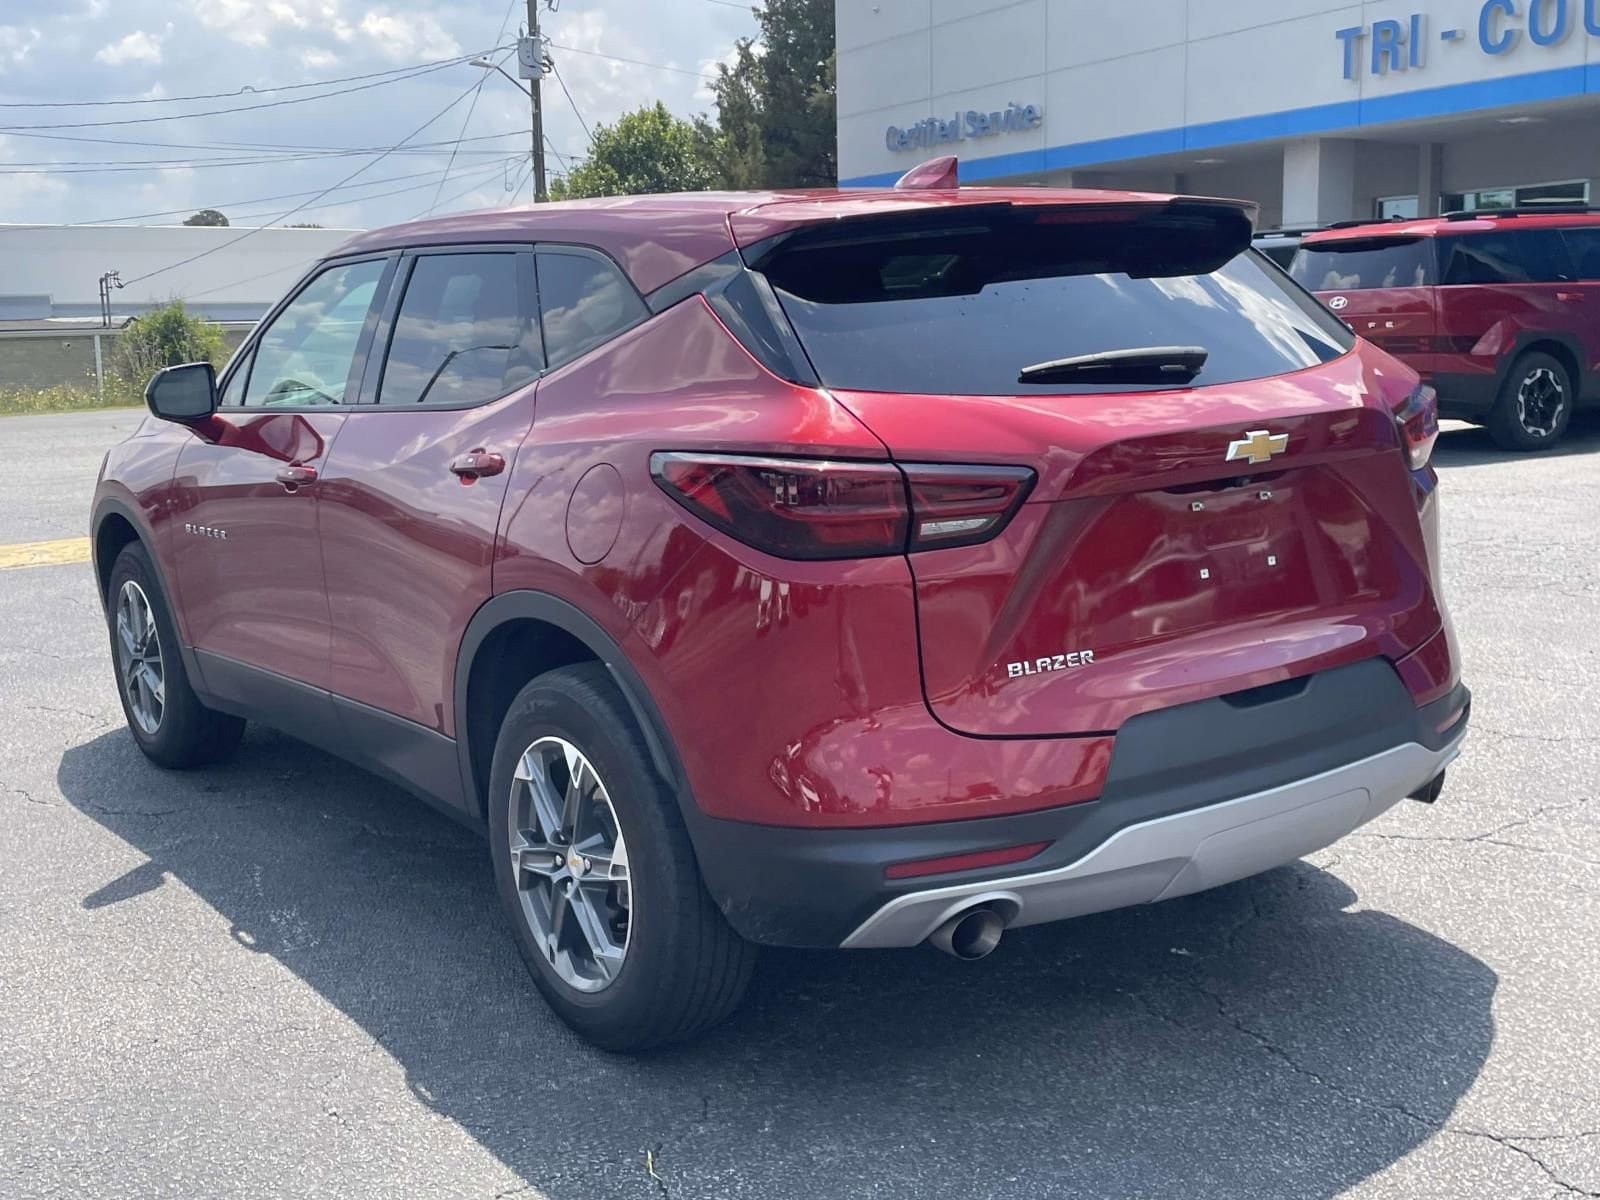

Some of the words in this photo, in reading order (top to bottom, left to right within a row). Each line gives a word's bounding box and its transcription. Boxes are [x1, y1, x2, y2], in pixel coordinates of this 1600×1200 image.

[1336, 14, 1427, 80] TRI
[886, 113, 964, 151] Certified
[967, 102, 1042, 138] Service
[185, 523, 227, 540] BLAZER
[1007, 649, 1095, 678] BLAZER
